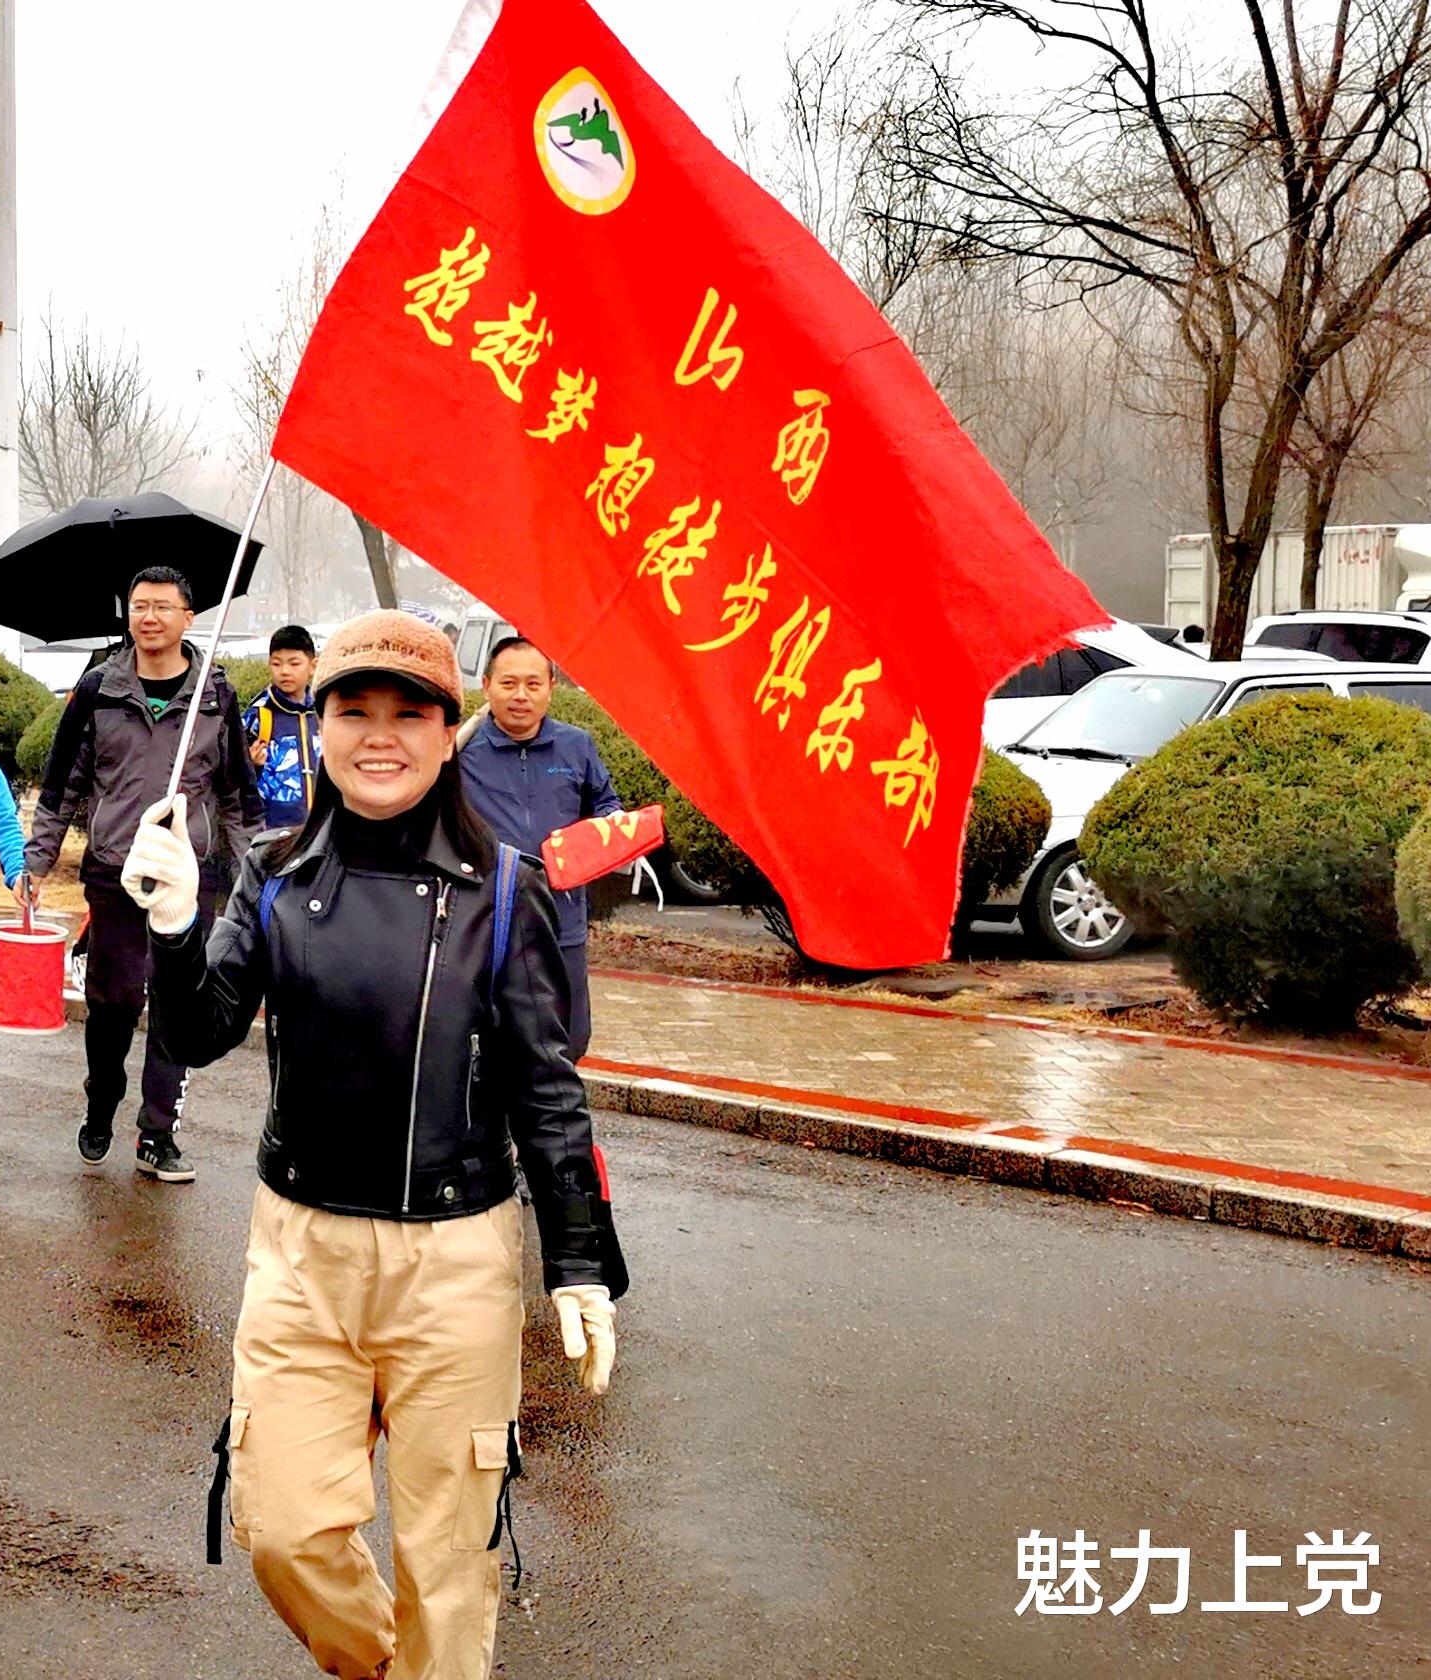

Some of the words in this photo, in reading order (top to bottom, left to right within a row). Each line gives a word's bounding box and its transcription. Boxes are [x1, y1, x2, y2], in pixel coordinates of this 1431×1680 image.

[404, 227, 939, 848] 超越梦想徒步俱乐部
[675, 288, 830, 505] 山西
